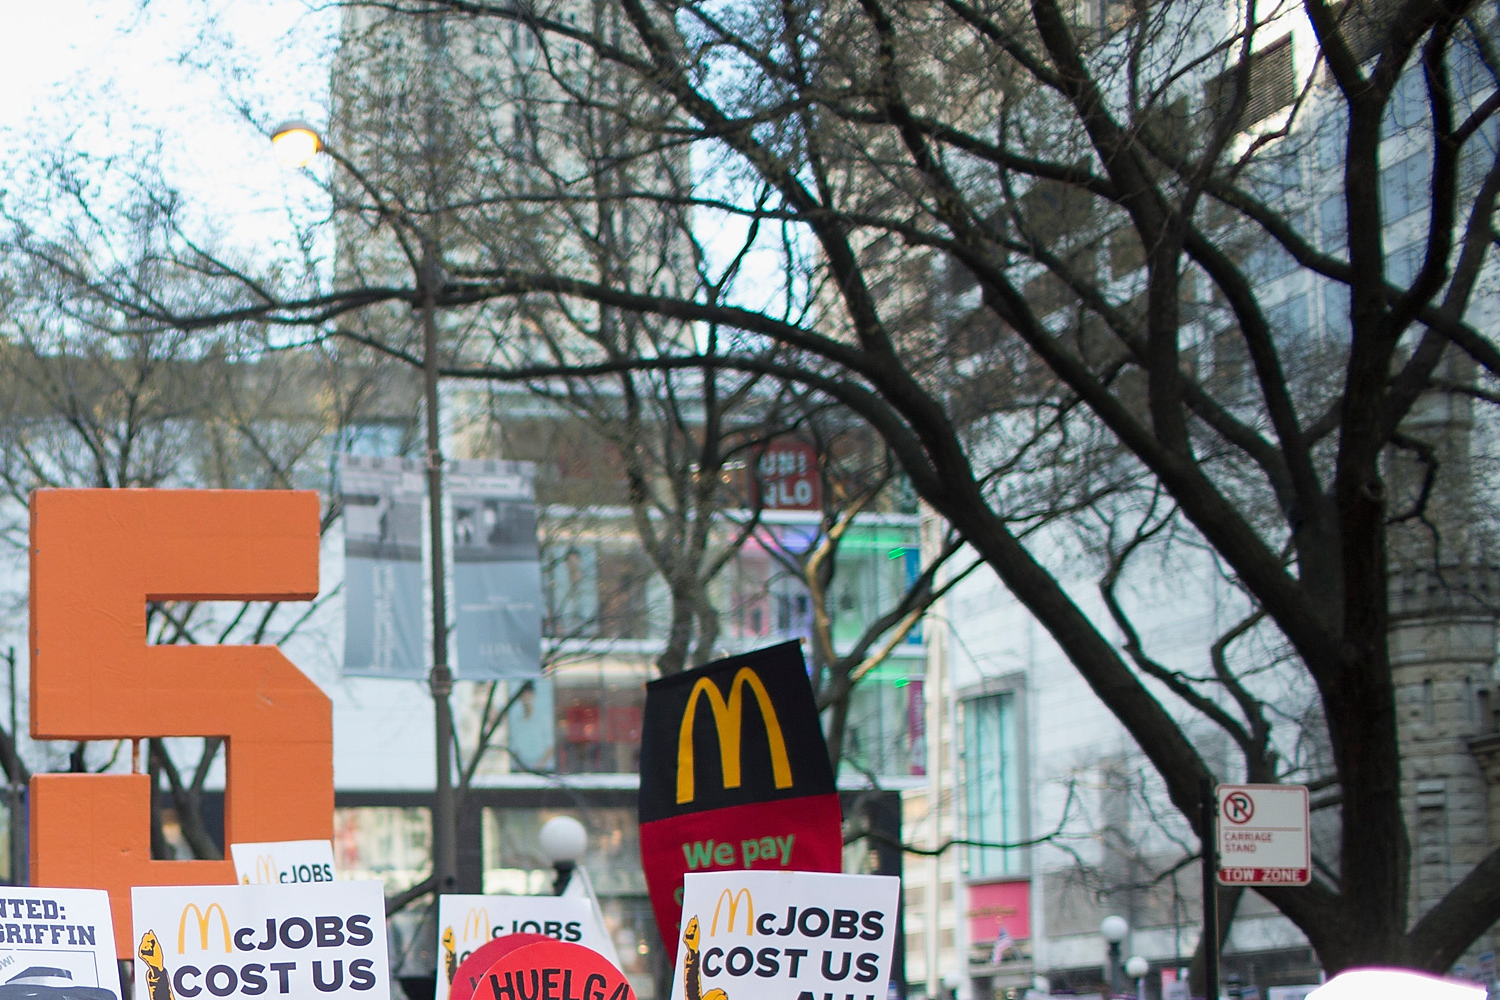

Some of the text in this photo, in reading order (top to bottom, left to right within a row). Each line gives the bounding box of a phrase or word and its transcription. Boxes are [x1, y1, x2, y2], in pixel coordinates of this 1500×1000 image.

[1224, 832, 1273, 843] CARRIAGE
[1225, 844, 1256, 853] STAND
[683, 834, 795, 869] We pay
[1225, 869, 1302, 881] TOW ZONE
[702, 946, 880, 983] COST US
[173, 958, 377, 998] COST US
